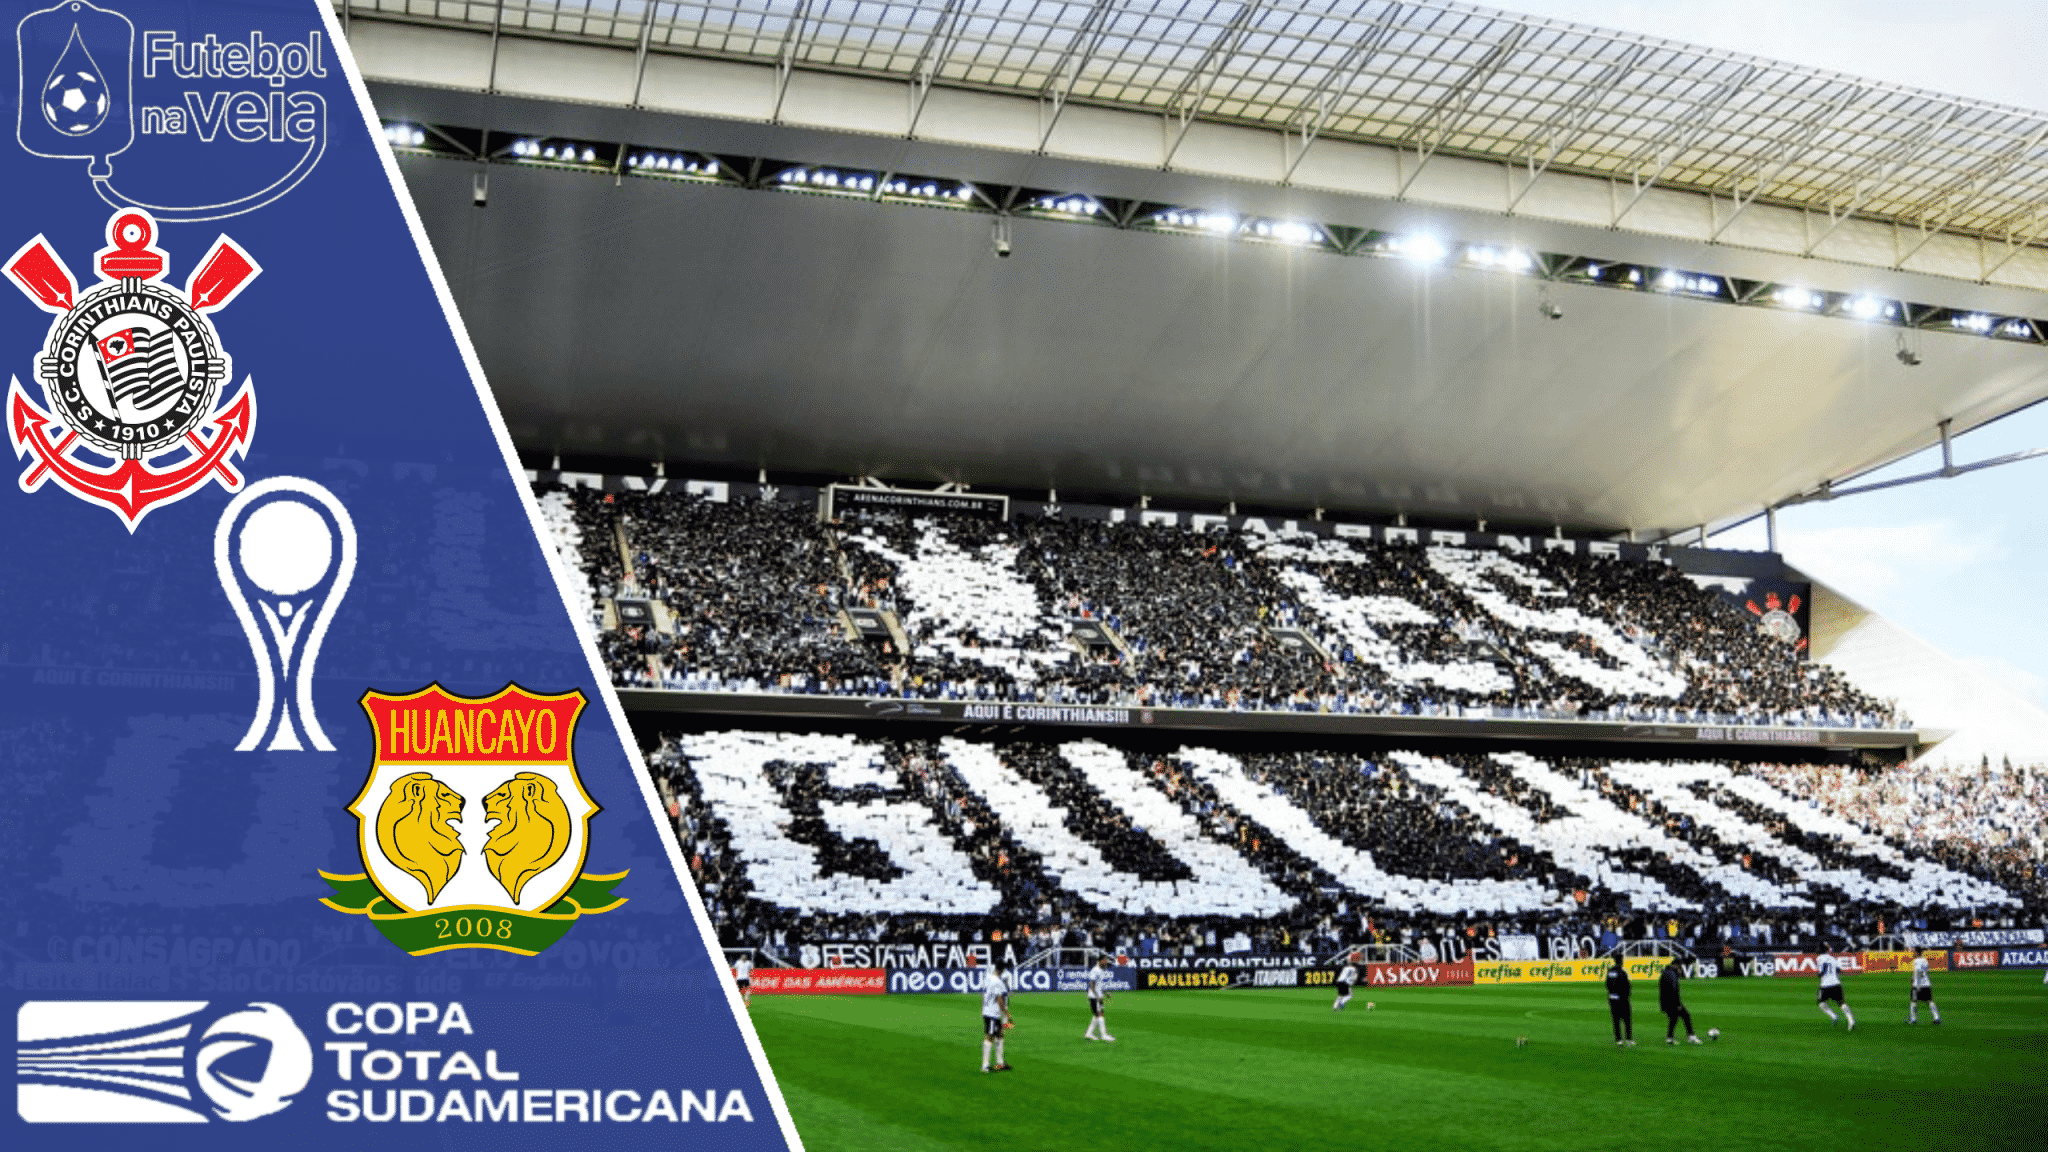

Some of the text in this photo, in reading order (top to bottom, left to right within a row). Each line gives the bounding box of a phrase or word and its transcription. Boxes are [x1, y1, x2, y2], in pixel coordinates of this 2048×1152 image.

[963, 704, 999, 719] AQUI
[1017, 705, 1129, 723] CORINTHIANS!!!
[823, 944, 898, 968] FESTA
[1126, 957, 1317, 968] ARENA CORINTHIANS
[1775, 957, 1863, 973] MAEL
[1148, 969, 1229, 987] PAULISTÃO
[1304, 971, 1335, 985] 2017
[1373, 967, 1440, 984] ASKOV
[1477, 963, 1522, 981] crefisa
[1529, 963, 1573, 980] crefisa
[1581, 962, 1612, 980] crefi
[815, 975, 885, 989] AMÉRICAS
[891, 970, 1050, 994] neo quica
